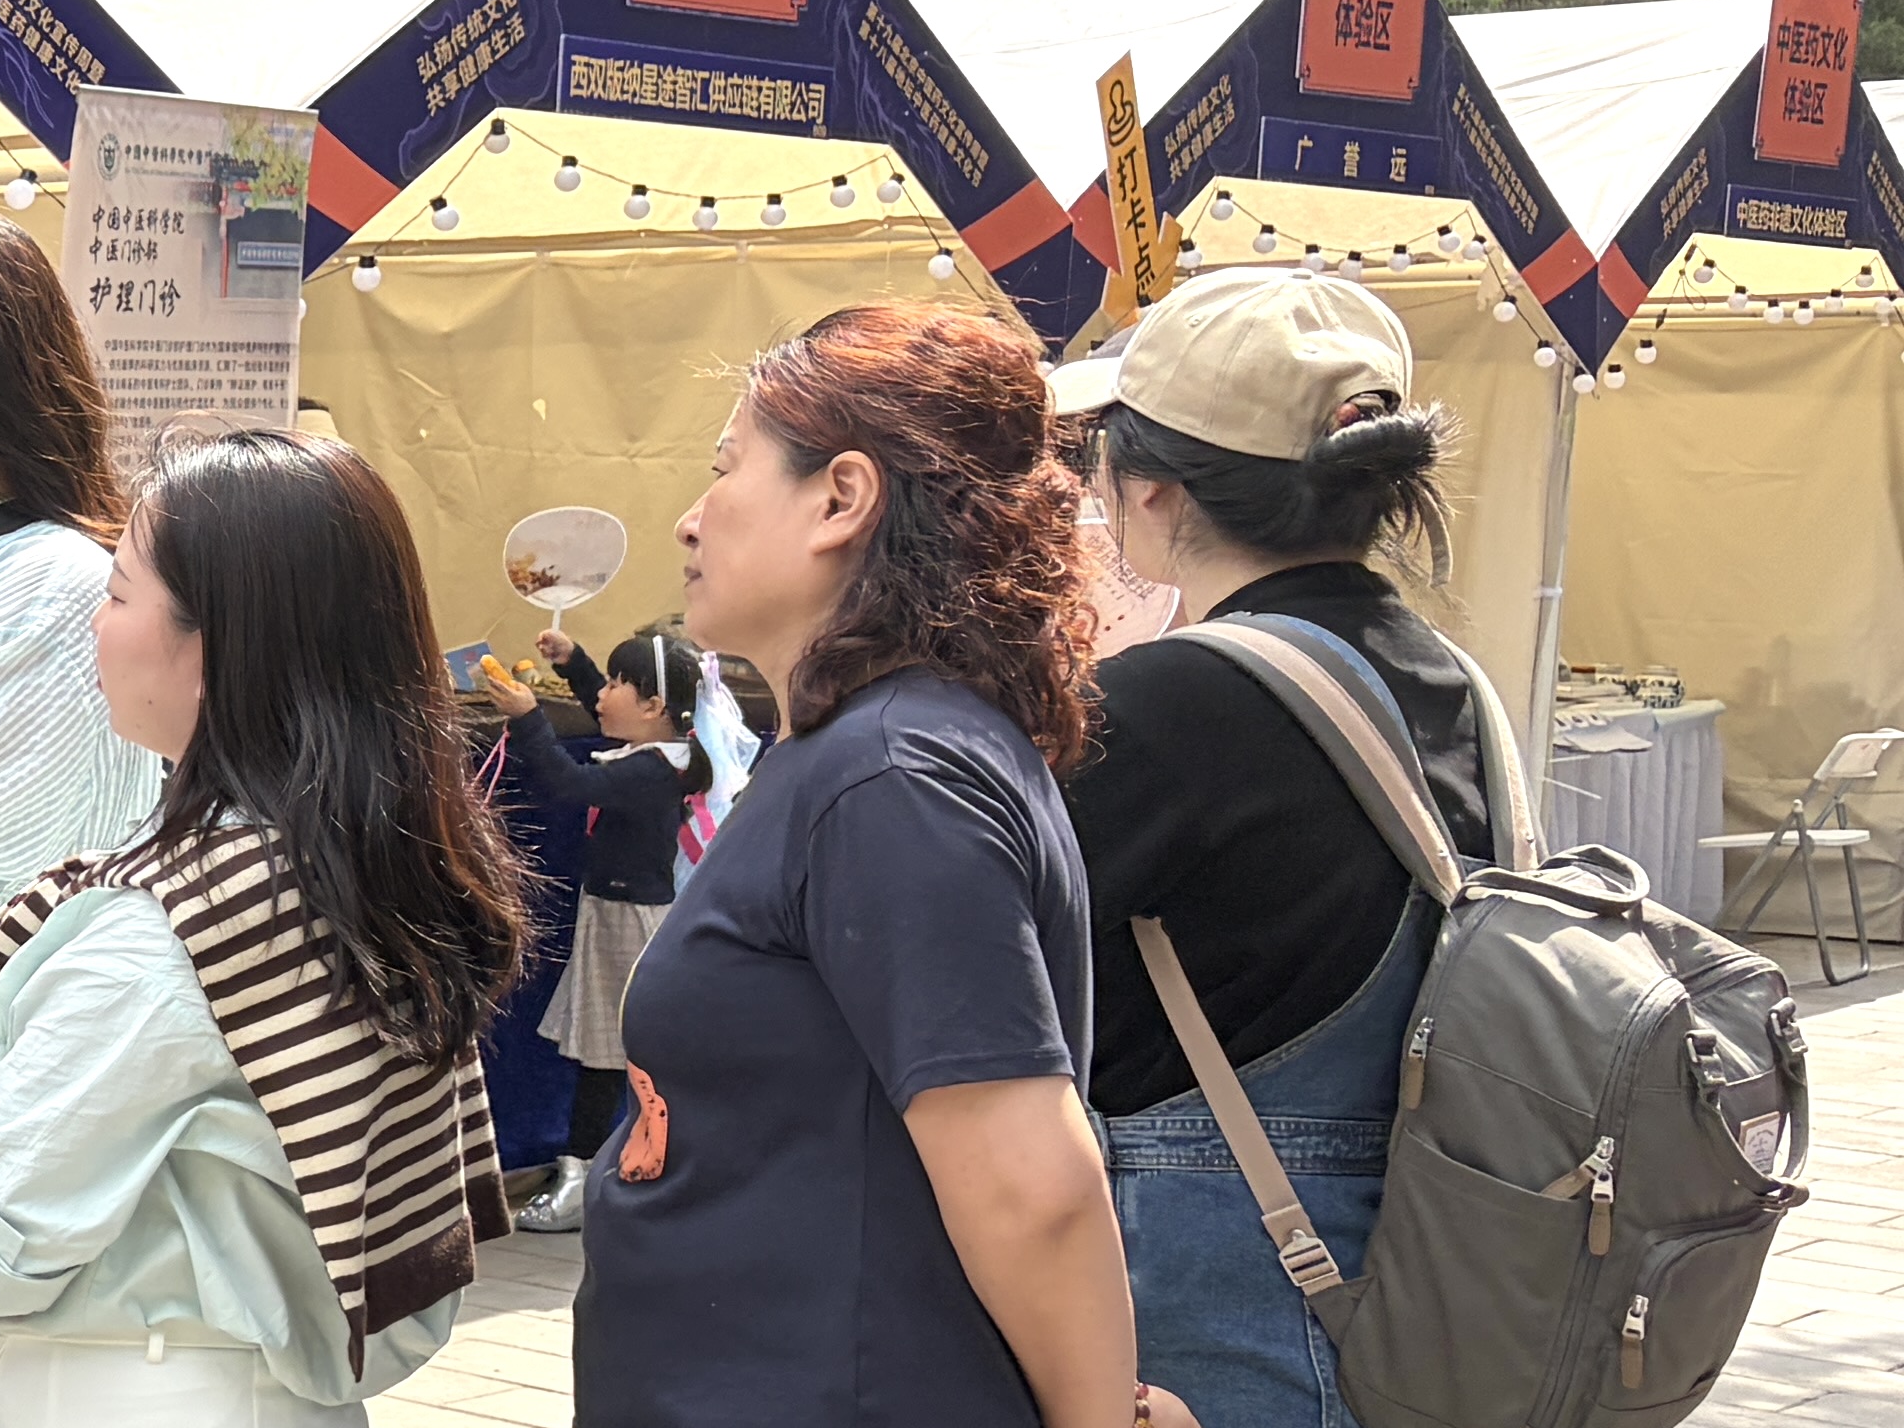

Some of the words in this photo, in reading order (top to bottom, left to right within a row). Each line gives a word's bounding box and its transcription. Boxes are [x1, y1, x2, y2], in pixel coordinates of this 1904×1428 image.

[1776, 20, 1849, 72] 中医药文化
[569, 54, 826, 124] 西双版纳星途智汇供应链有限公司
[1782, 76, 1829, 125] 体验区
[1294, 134, 1408, 184] 广誉远
[92, 204, 185, 236] 中国中医科学院
[1116, 145, 1156, 299] 打卡点
[89, 235, 159, 265] 中医门诊部
[89, 276, 181, 318] 护理门诊
